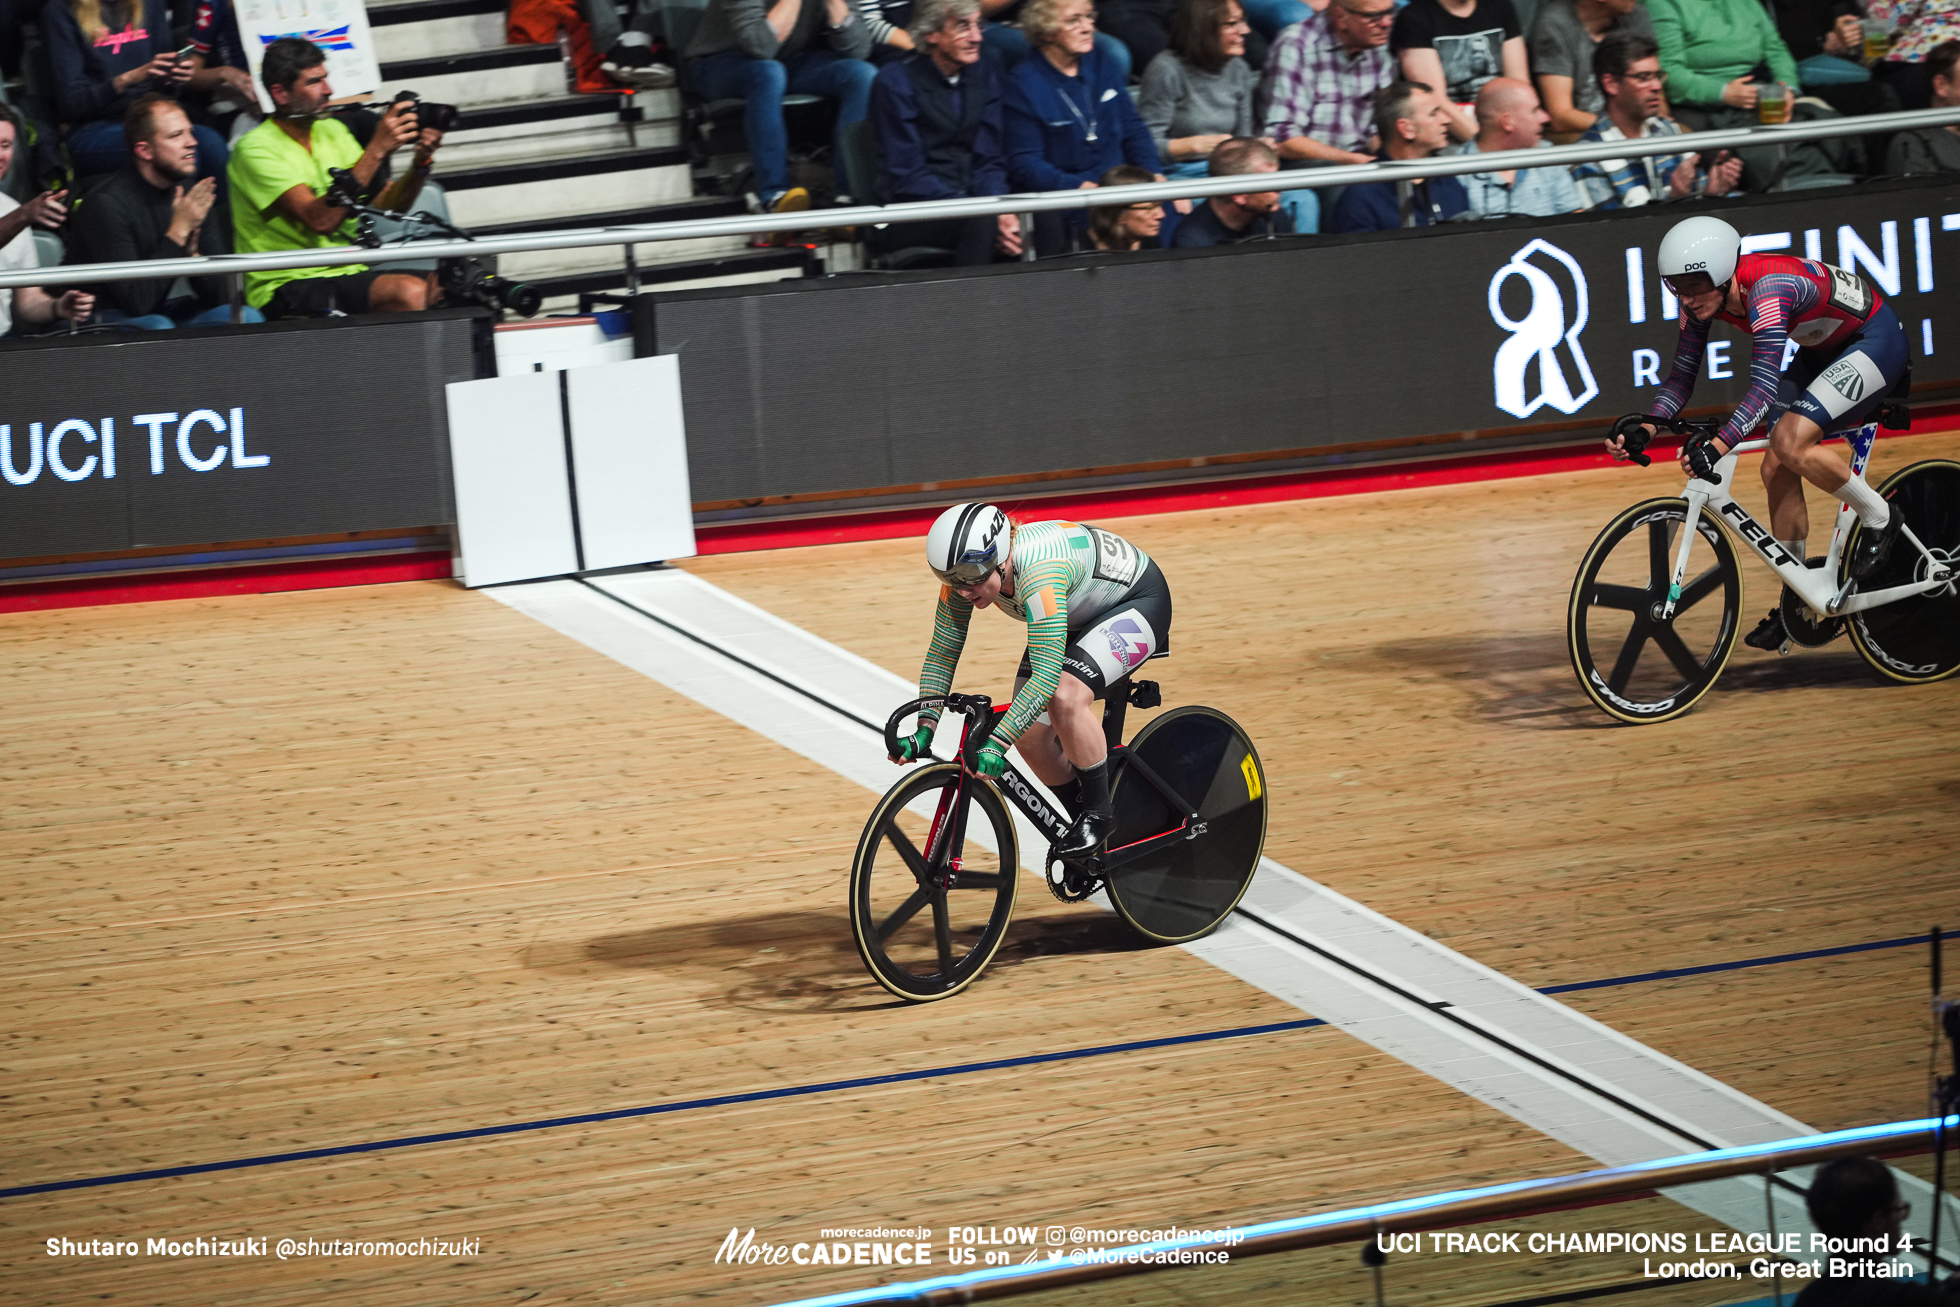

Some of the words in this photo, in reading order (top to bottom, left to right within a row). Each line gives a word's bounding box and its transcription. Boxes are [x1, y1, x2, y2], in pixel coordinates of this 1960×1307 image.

[1825, 363, 1851, 379] USA
[1830, 368, 1855, 384] CYCLING
[1741, 401, 1769, 436] Santini
[0, 417, 117, 486] UCI
[132, 407, 271, 476] TCL
[1101, 532, 1128, 561] 51
[1721, 501, 1800, 567] FELT
[1590, 667, 1676, 714] CORIMA
[1014, 692, 1046, 731] Santini
[1000, 770, 1057, 828] RGON
